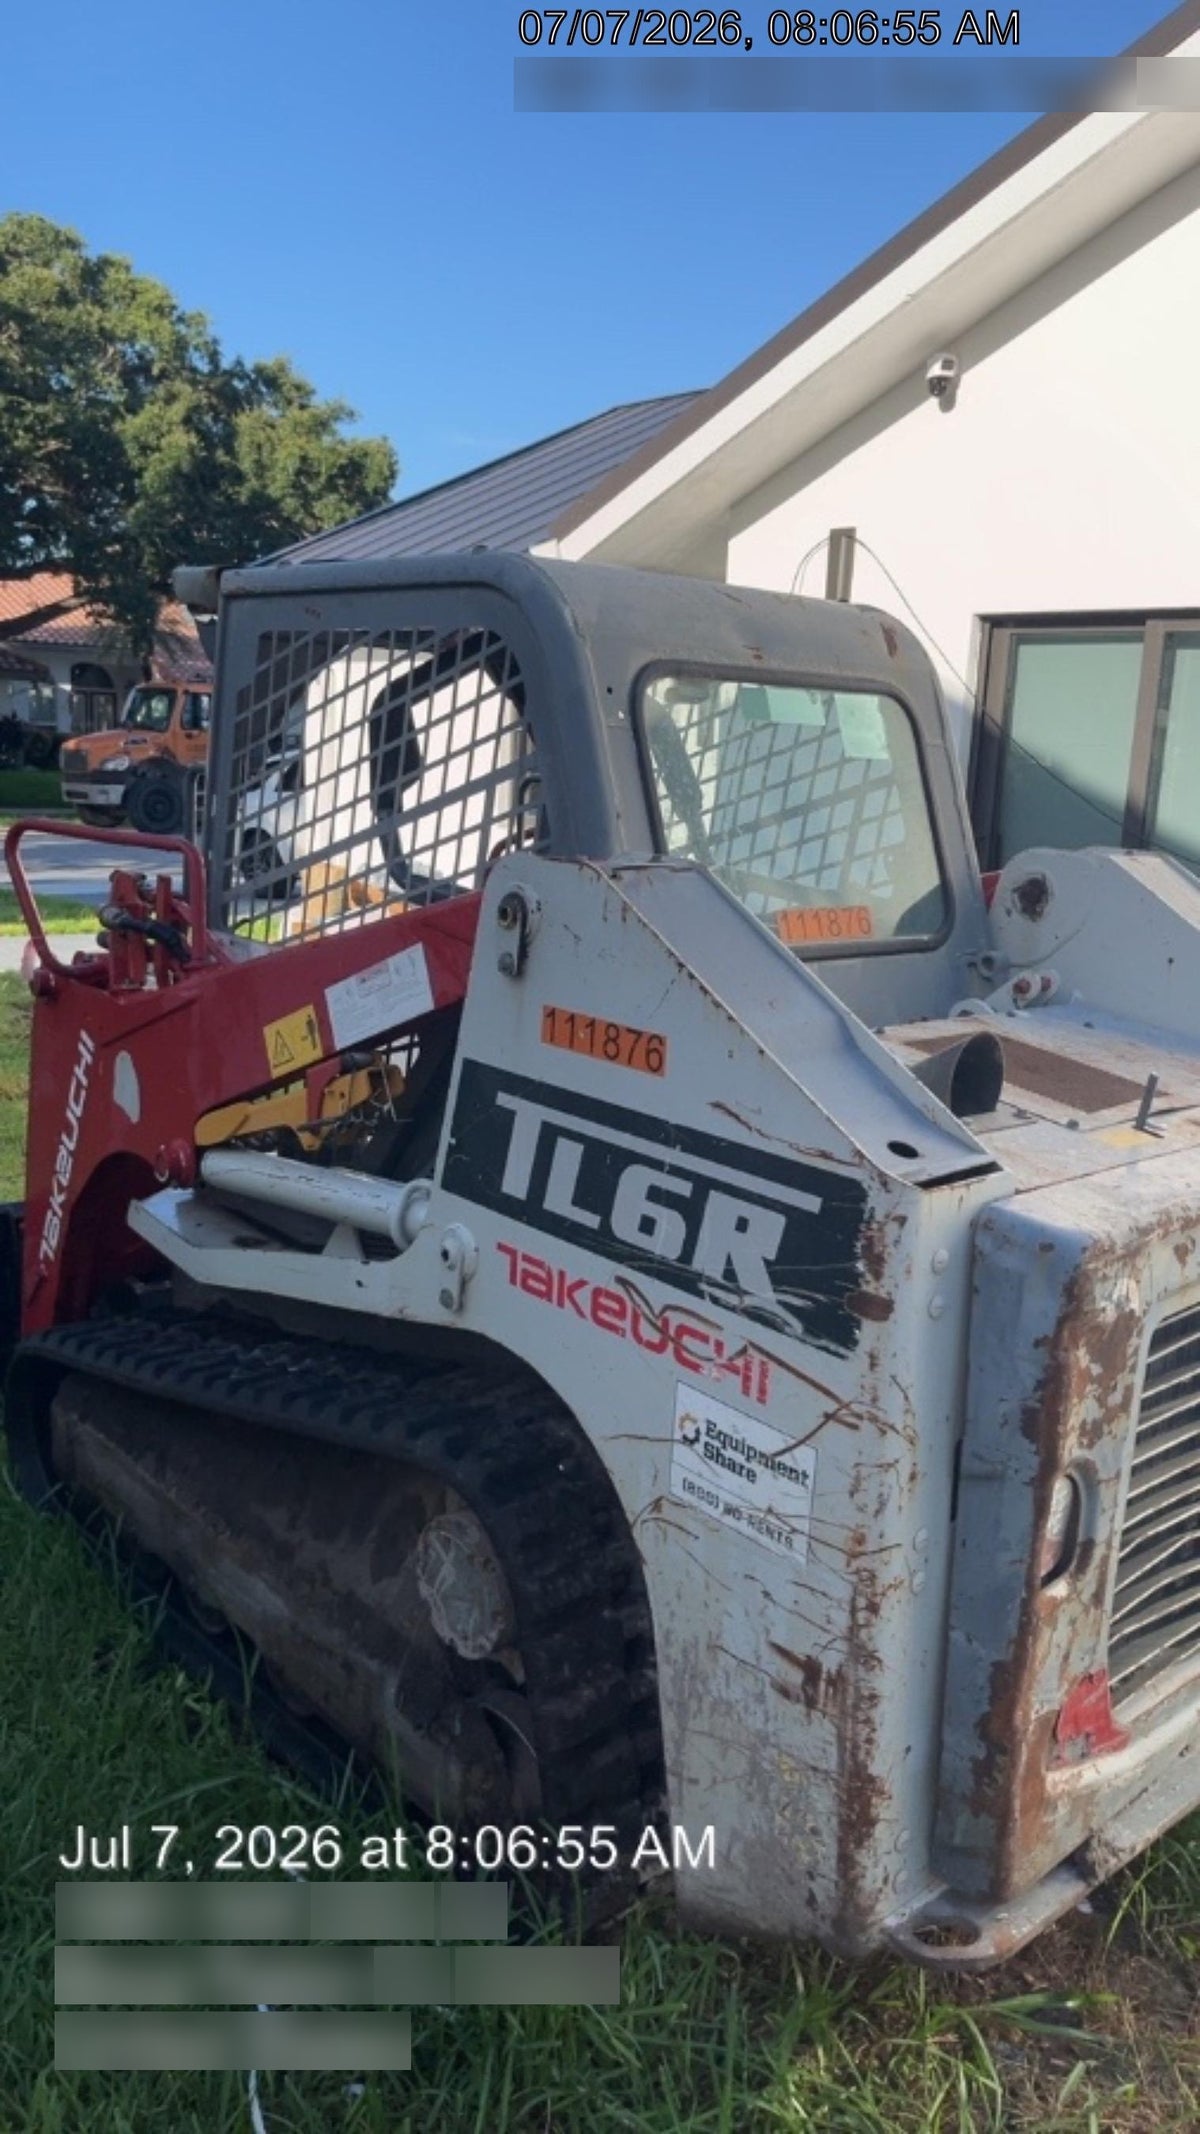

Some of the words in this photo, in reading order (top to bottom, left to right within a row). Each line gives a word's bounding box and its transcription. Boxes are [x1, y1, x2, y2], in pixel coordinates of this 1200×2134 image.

[779, 905, 872, 942] 111876
[543, 1007, 665, 1073] 111876
[495, 1090, 822, 1335] TL6R
[703, 1441, 758, 1485] Share
[705, 1418, 809, 1488] Equipment
